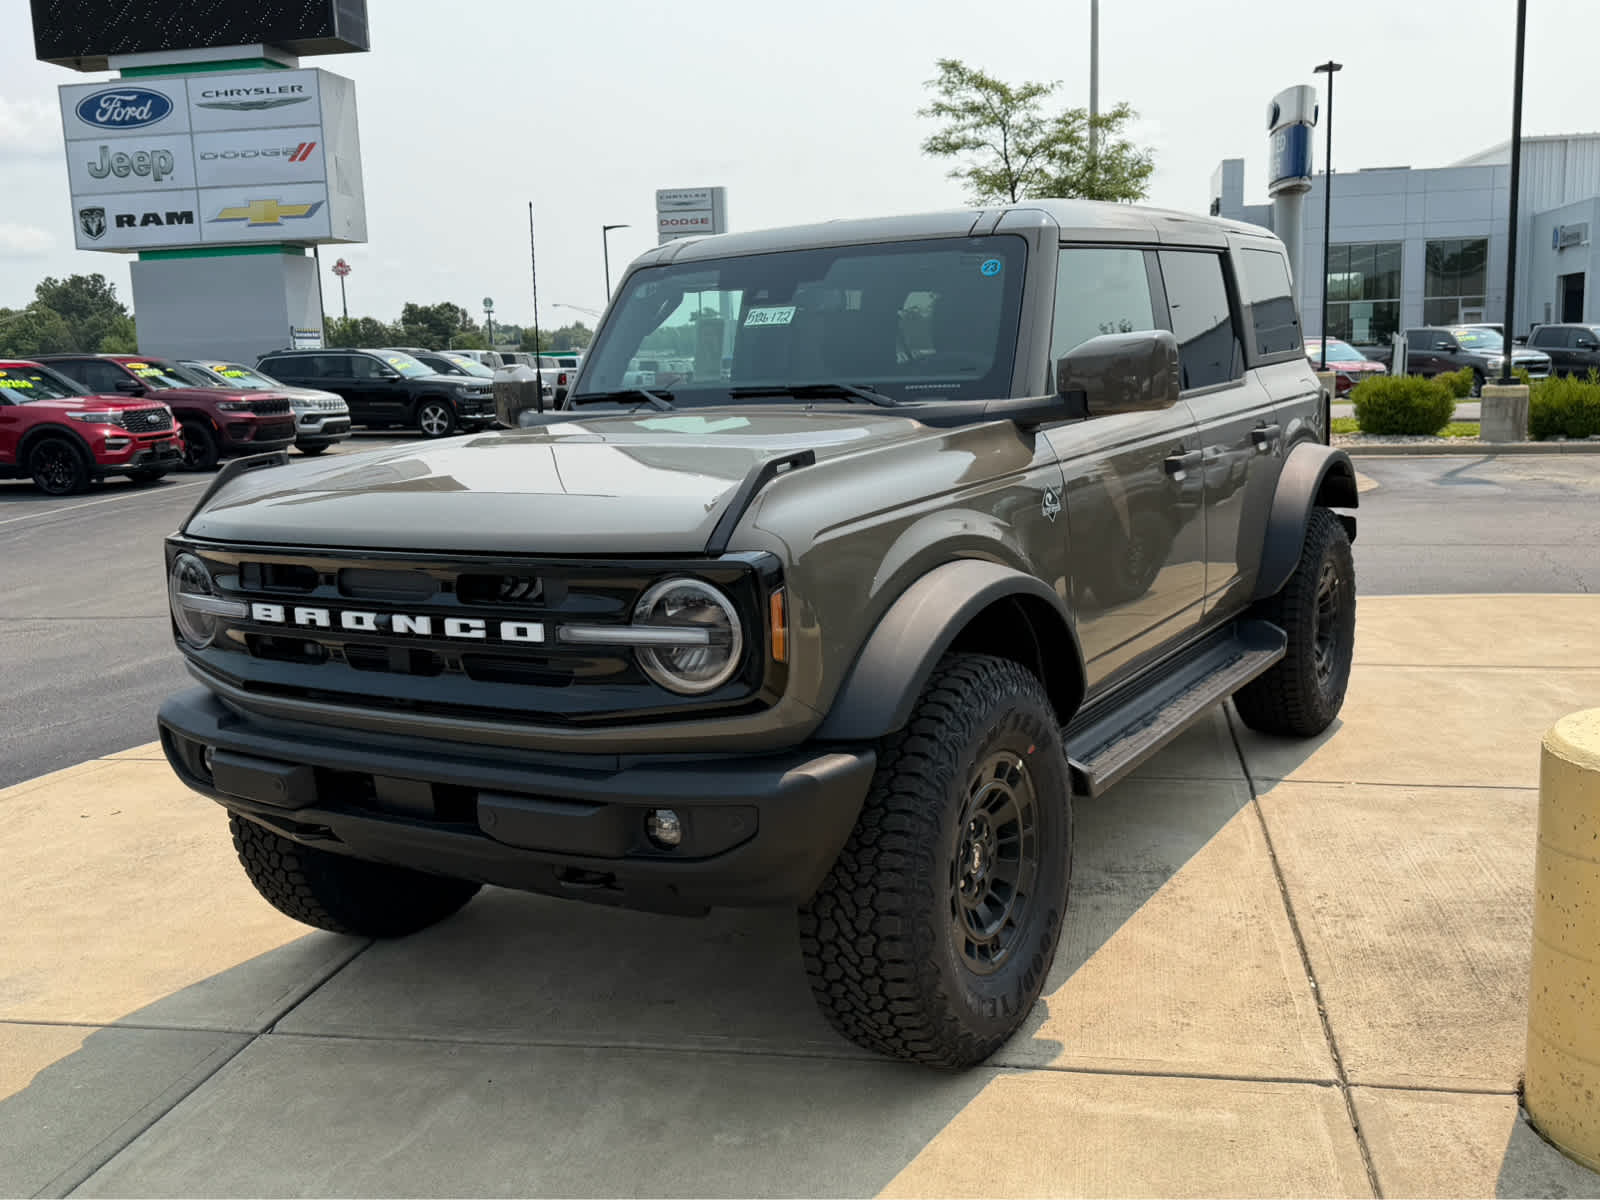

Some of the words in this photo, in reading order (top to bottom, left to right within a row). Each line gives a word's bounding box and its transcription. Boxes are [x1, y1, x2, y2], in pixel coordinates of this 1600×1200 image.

[201, 84, 304, 98] CHRYSLER
[96, 94, 153, 122] Ford
[200, 148, 299, 160] DODGE
[87, 145, 174, 182] Jeep
[115, 210, 194, 228] RAM
[660, 217, 709, 225] DODGE
[251, 602, 545, 642] BRONCO
